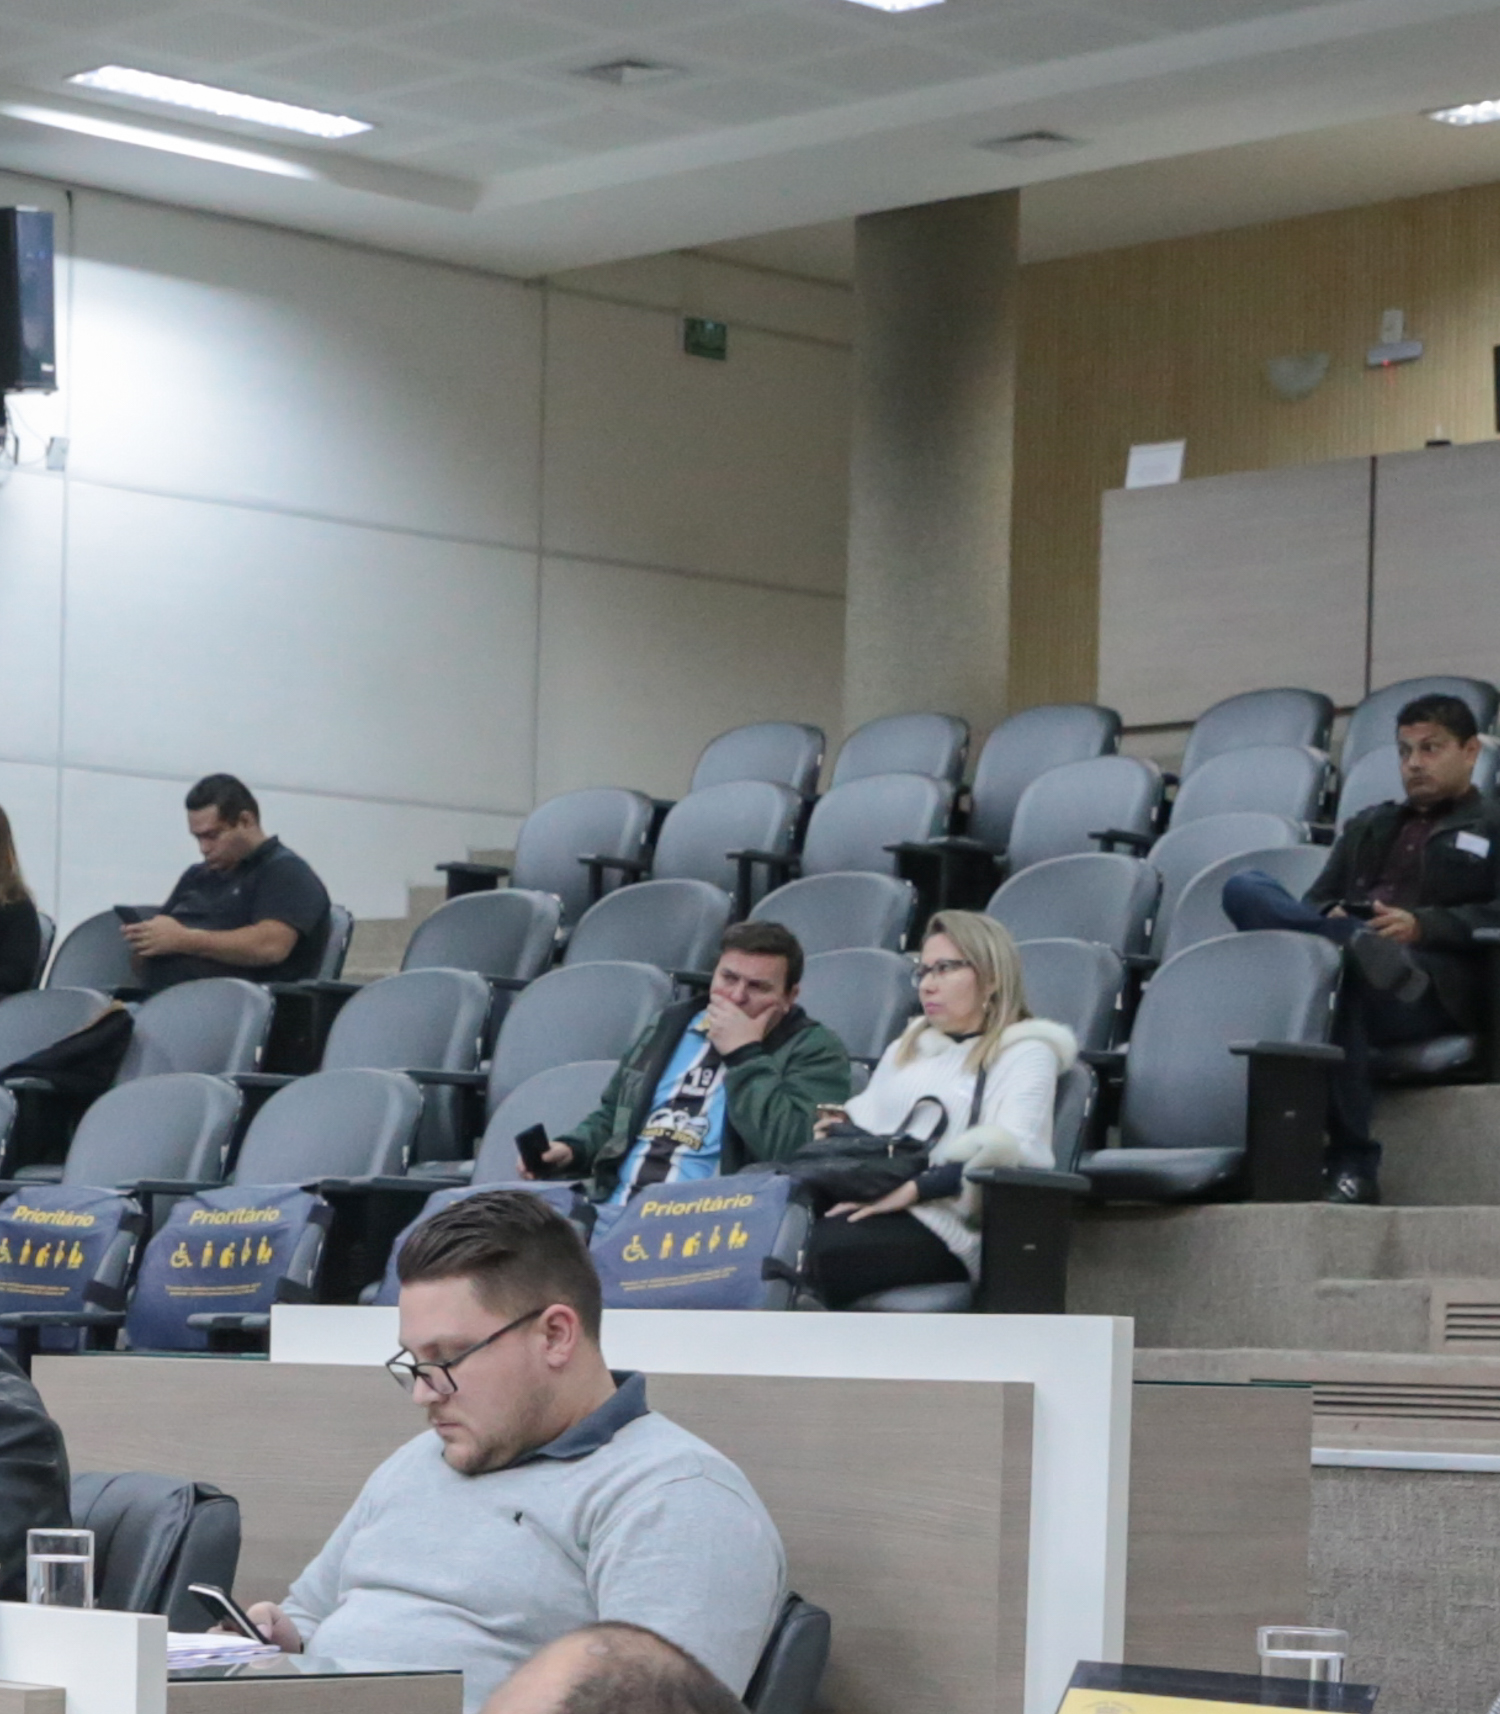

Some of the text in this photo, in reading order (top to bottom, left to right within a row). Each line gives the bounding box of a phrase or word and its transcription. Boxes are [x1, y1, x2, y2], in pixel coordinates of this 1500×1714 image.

[11, 1204, 96, 1228] Prioritário
[188, 1206, 281, 1226] Prioritário
[639, 1193, 755, 1219] Prioritário
